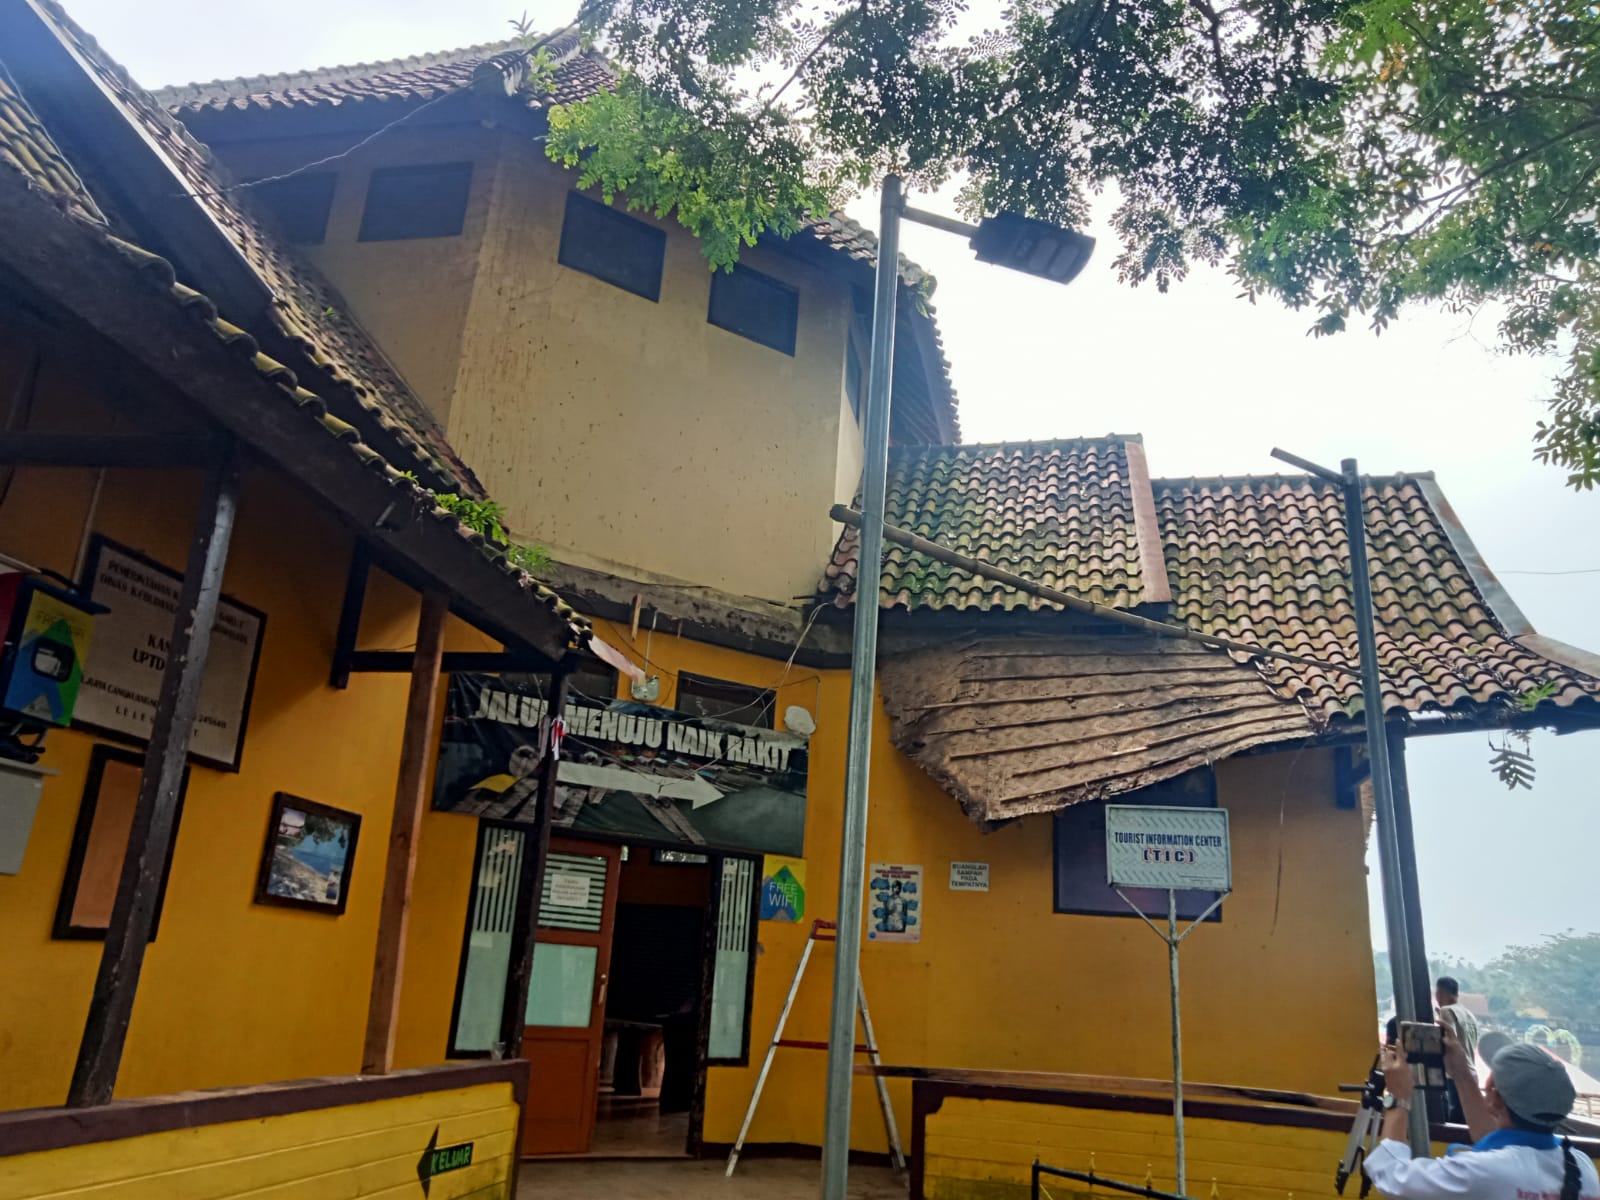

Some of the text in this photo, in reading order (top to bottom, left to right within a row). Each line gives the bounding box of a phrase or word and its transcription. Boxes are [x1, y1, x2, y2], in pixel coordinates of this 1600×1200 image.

[131, 647, 166, 672] UPTD
[564, 703, 662, 748] MENUJU
[666, 720, 722, 760] NAIK
[726, 732, 792, 772] RAKIT
[1114, 832, 1222, 848] TOURIST INFORMATION CENTER
[1143, 849, 1194, 863] (TIC)
[769, 881, 798, 896] FREE
[768, 893, 798, 908] WIFI
